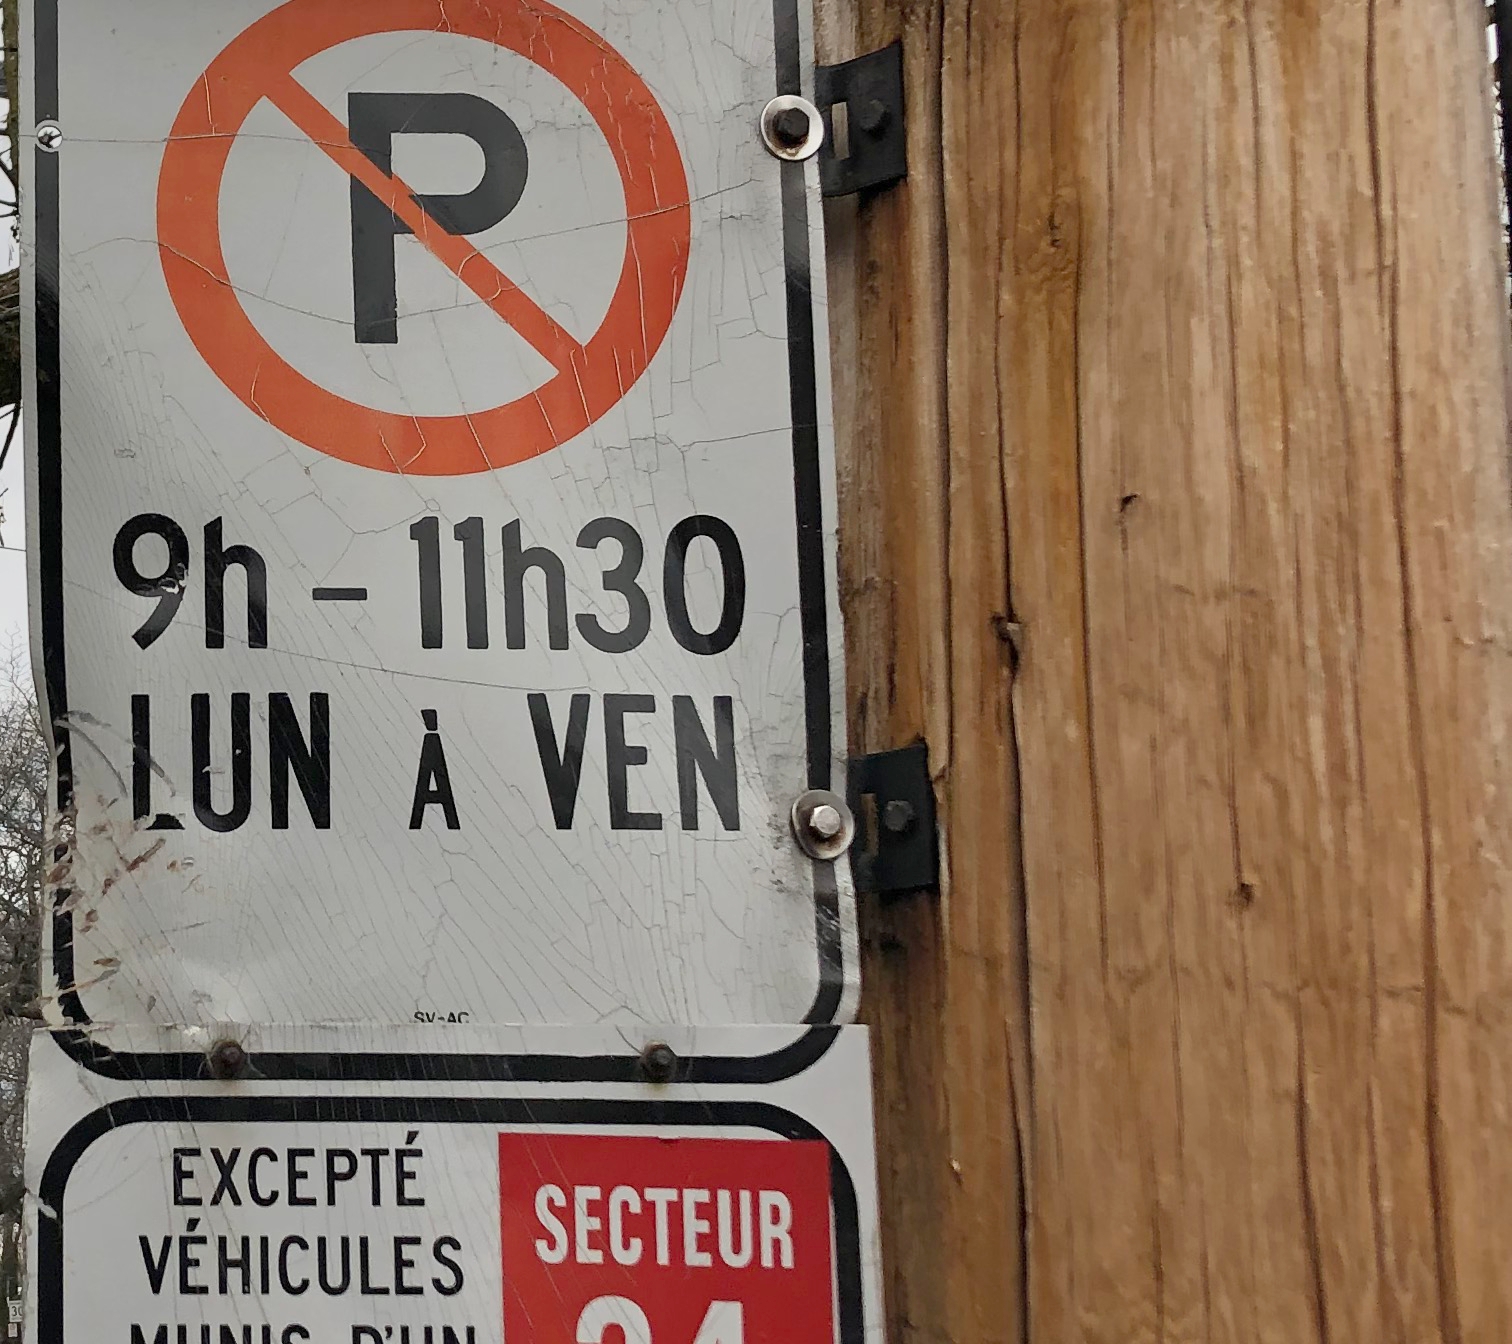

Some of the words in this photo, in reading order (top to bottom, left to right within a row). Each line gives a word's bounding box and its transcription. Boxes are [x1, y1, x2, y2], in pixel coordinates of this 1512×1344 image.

[348, 91, 529, 345] P
[112, 512, 269, 651] 9h
[409, 514, 747, 656] 11h30
[130, 691, 331, 833] LUN
[408, 707, 461, 831] À
[526, 692, 741, 832] VEN
[172, 1131, 426, 1208] EXCEPTÉ
[534, 1184, 793, 1268] SECTEUR
[138, 1218, 464, 1297] VÉHICULES
